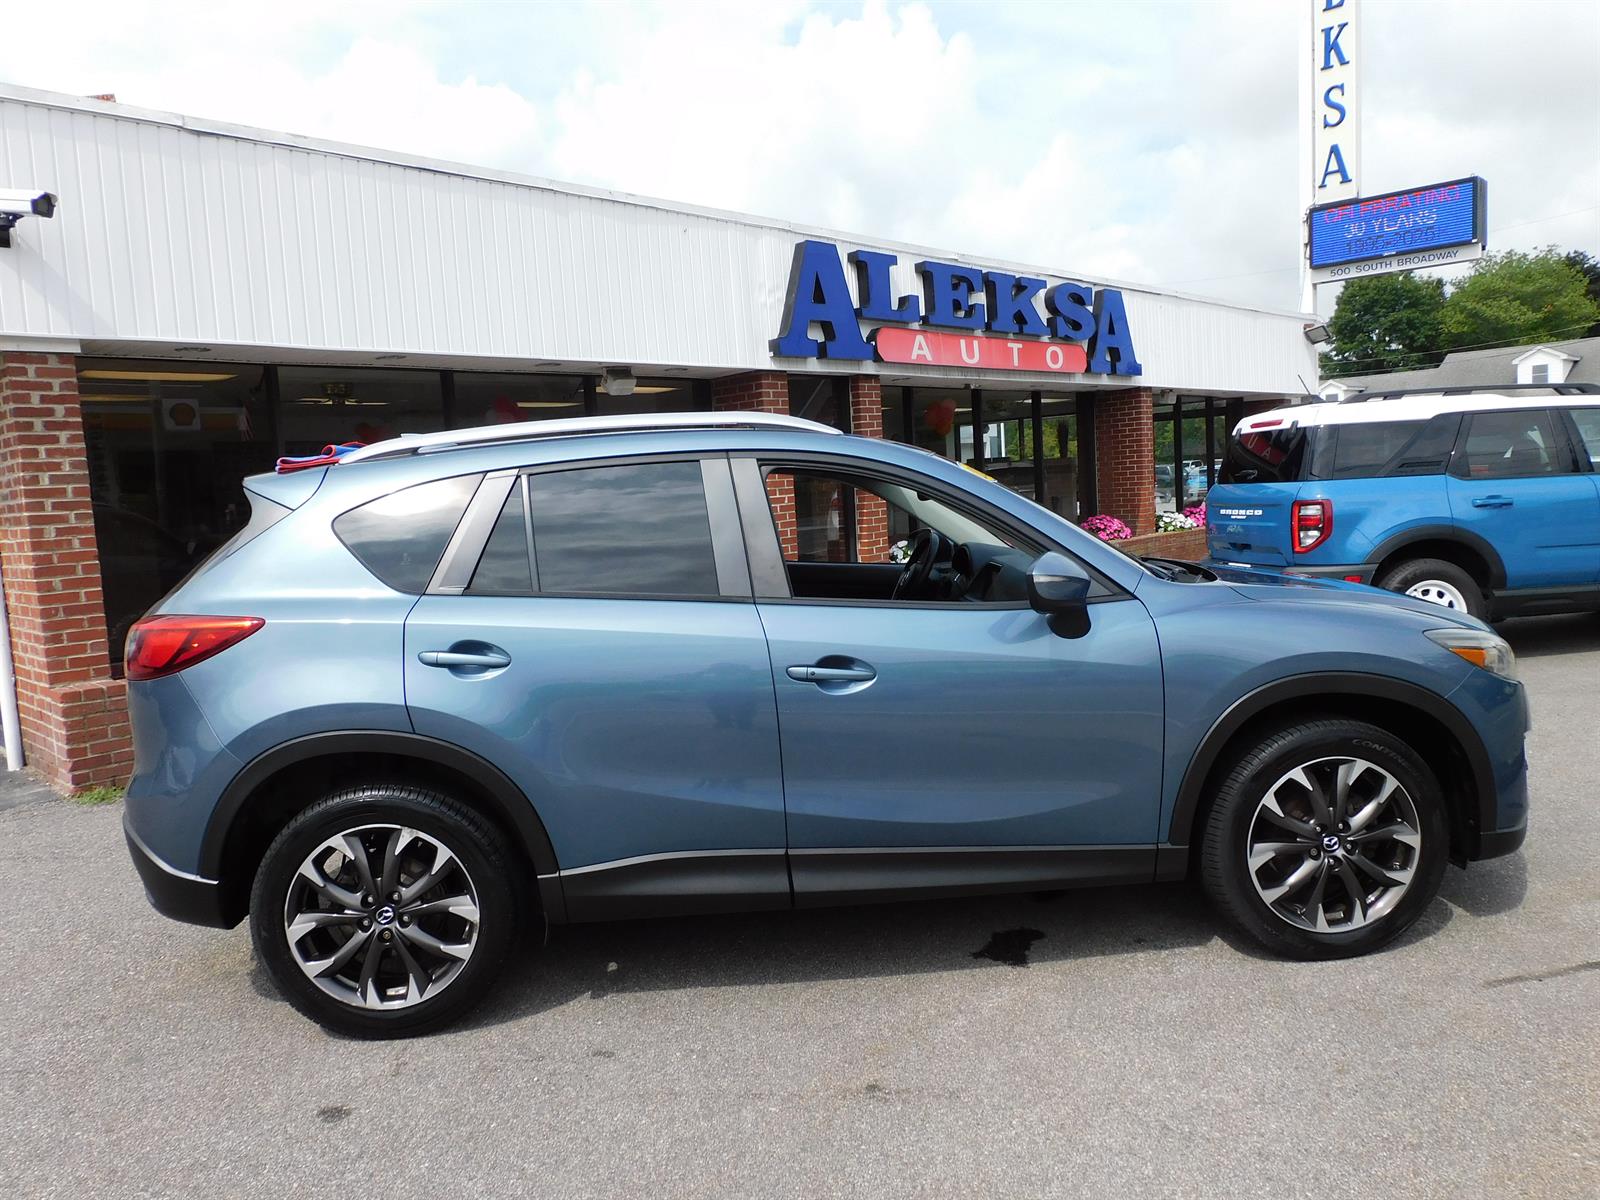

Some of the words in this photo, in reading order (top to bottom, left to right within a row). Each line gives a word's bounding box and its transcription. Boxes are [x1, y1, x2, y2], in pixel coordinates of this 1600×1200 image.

[1344, 221, 1366, 238] 30
[1330, 267, 1351, 277] 500
[1355, 261, 1392, 274] SOUTH
[1397, 250, 1460, 267] BROADWAY
[768, 240, 1142, 376] ALEKSA
[910, 334, 1065, 370] AUTO
